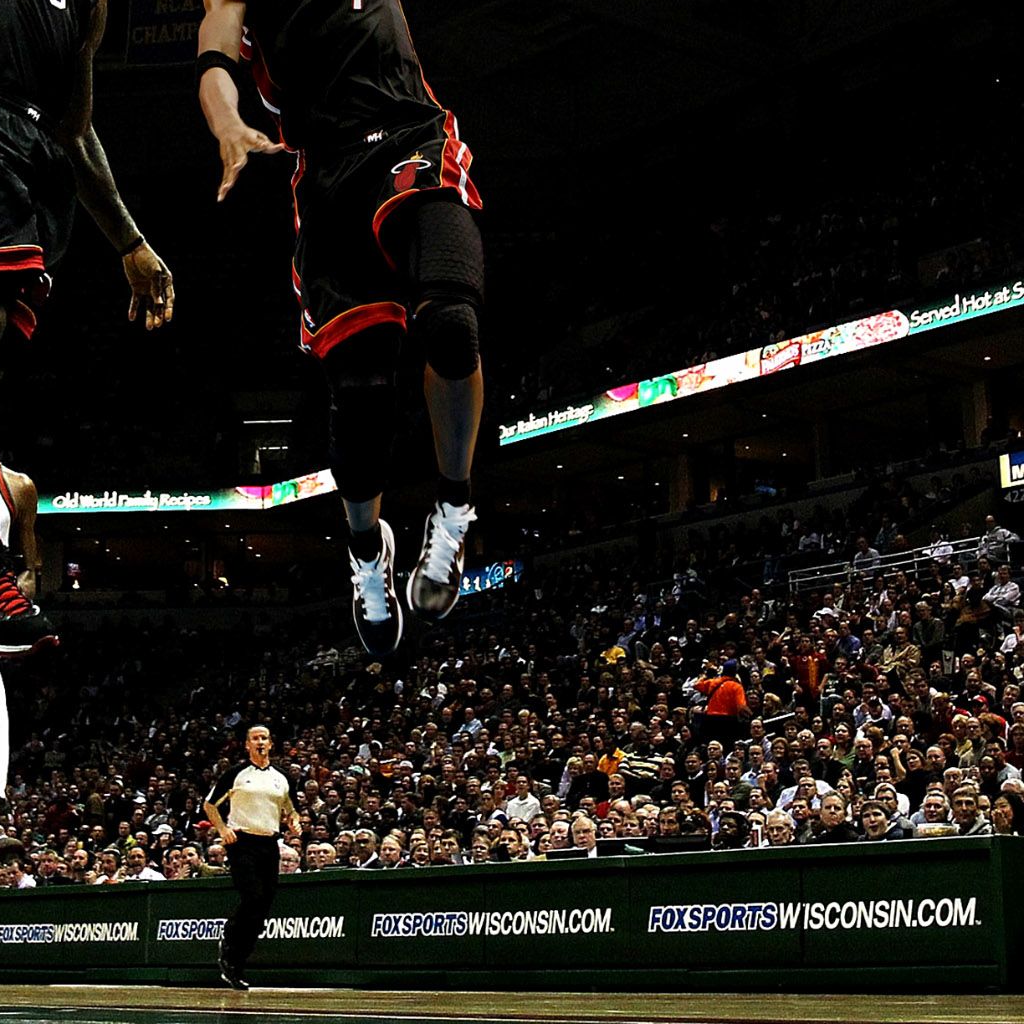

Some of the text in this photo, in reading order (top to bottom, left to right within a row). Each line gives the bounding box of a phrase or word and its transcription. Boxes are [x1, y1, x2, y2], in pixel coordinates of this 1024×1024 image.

[910, 293, 960, 327] Served
[962, 291, 992, 314] Hot
[994, 286, 1010, 306] at
[52, 491, 79, 508] Old
[80, 490, 118, 508] World
[160, 492, 212, 511] Recipes
